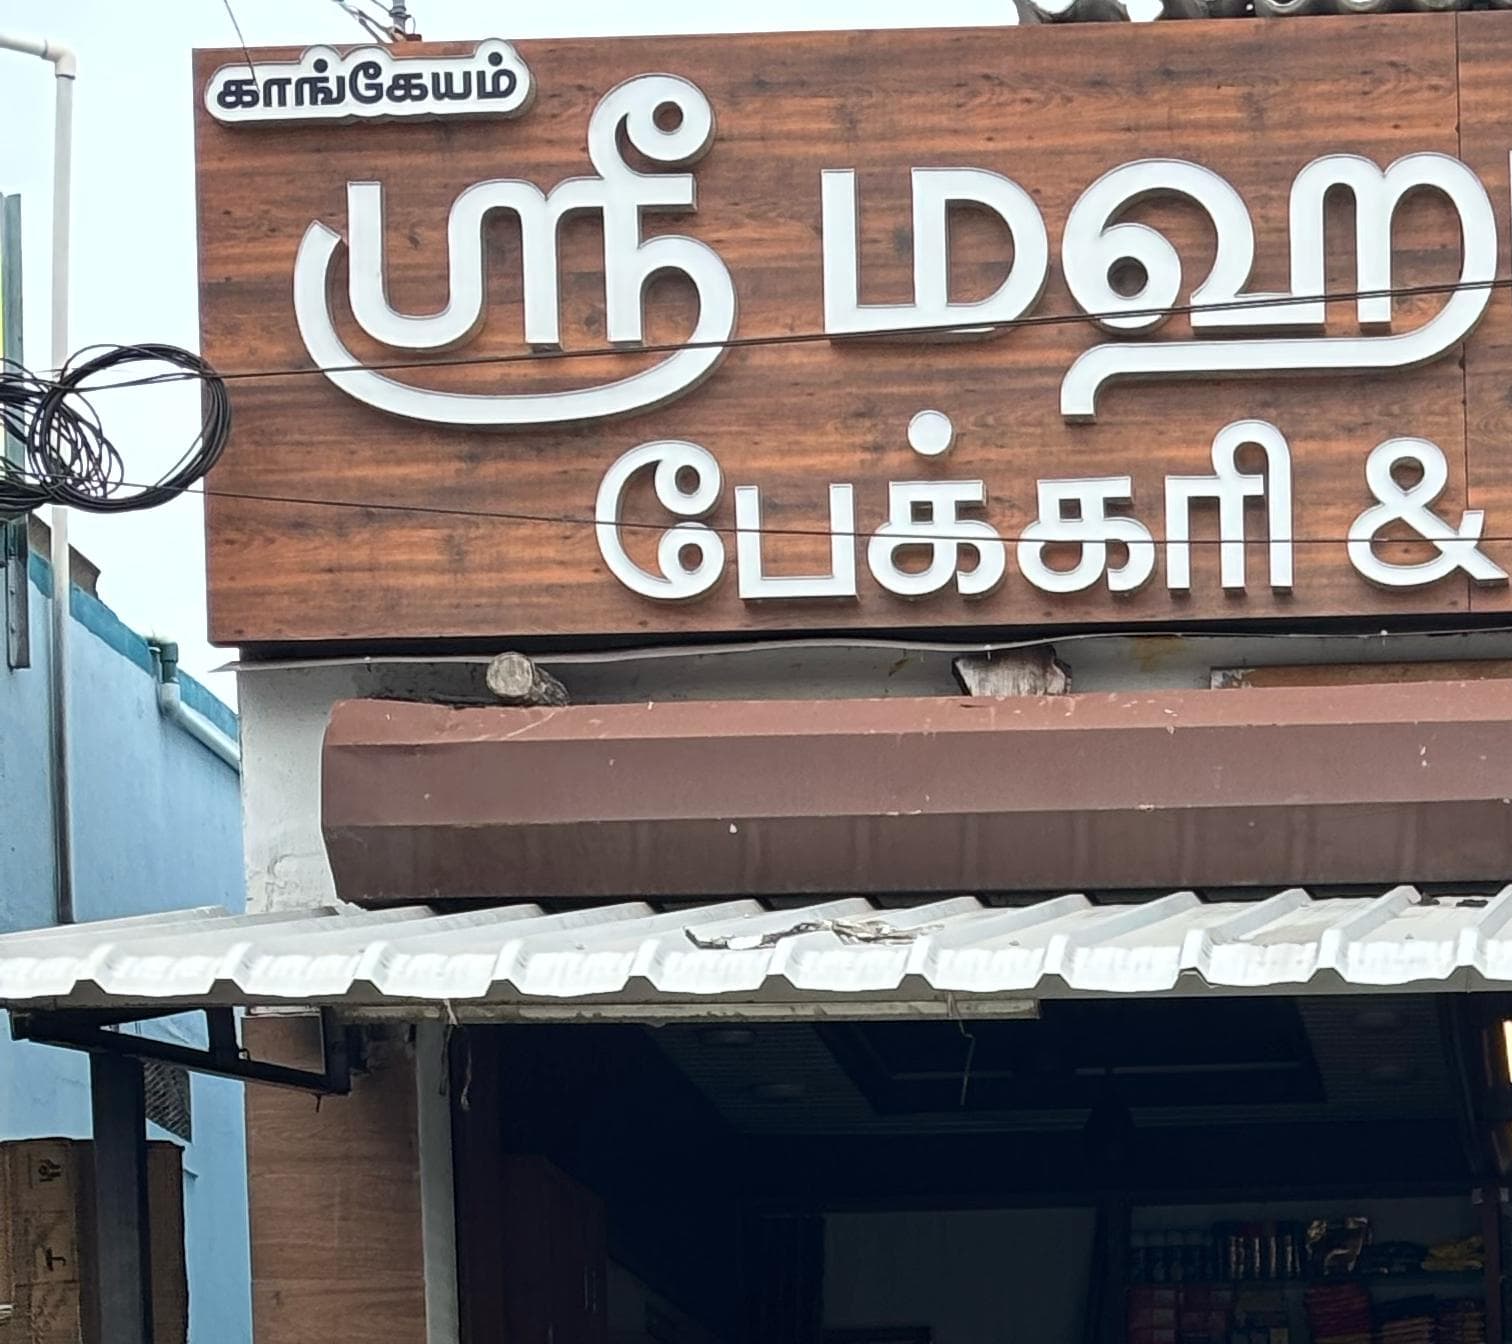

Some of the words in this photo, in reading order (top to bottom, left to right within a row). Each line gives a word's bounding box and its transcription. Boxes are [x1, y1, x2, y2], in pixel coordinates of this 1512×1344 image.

[216, 51, 518, 109] காங்கேயம்
[594, 410, 1294, 600] பேக்கரி
[1346, 436, 1510, 587] &
